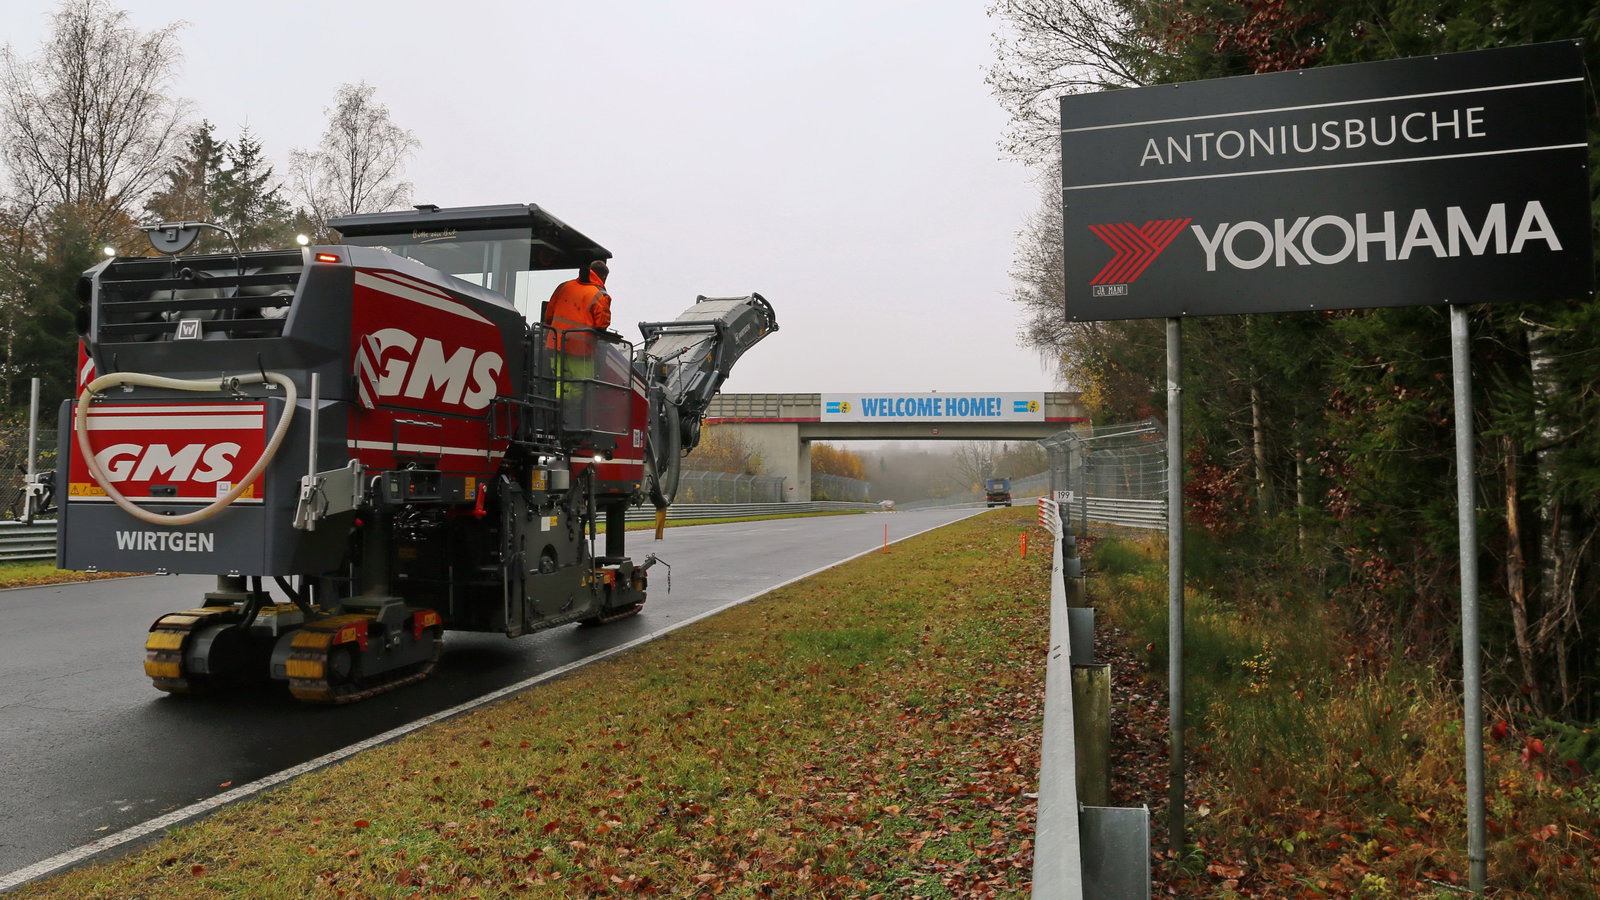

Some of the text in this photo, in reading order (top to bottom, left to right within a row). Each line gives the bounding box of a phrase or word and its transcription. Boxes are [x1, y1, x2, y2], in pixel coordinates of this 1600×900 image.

[1140, 107, 1486, 167] ANTONIUSBUCHE
[1191, 200, 1563, 272] YOKOHAMA
[354, 328, 504, 410] GMS
[861, 397, 1002, 417] WELCOME HOME!
[88, 442, 242, 483] GMS
[1057, 491, 1070, 499] 199
[116, 531, 214, 552] WIRTGEN
